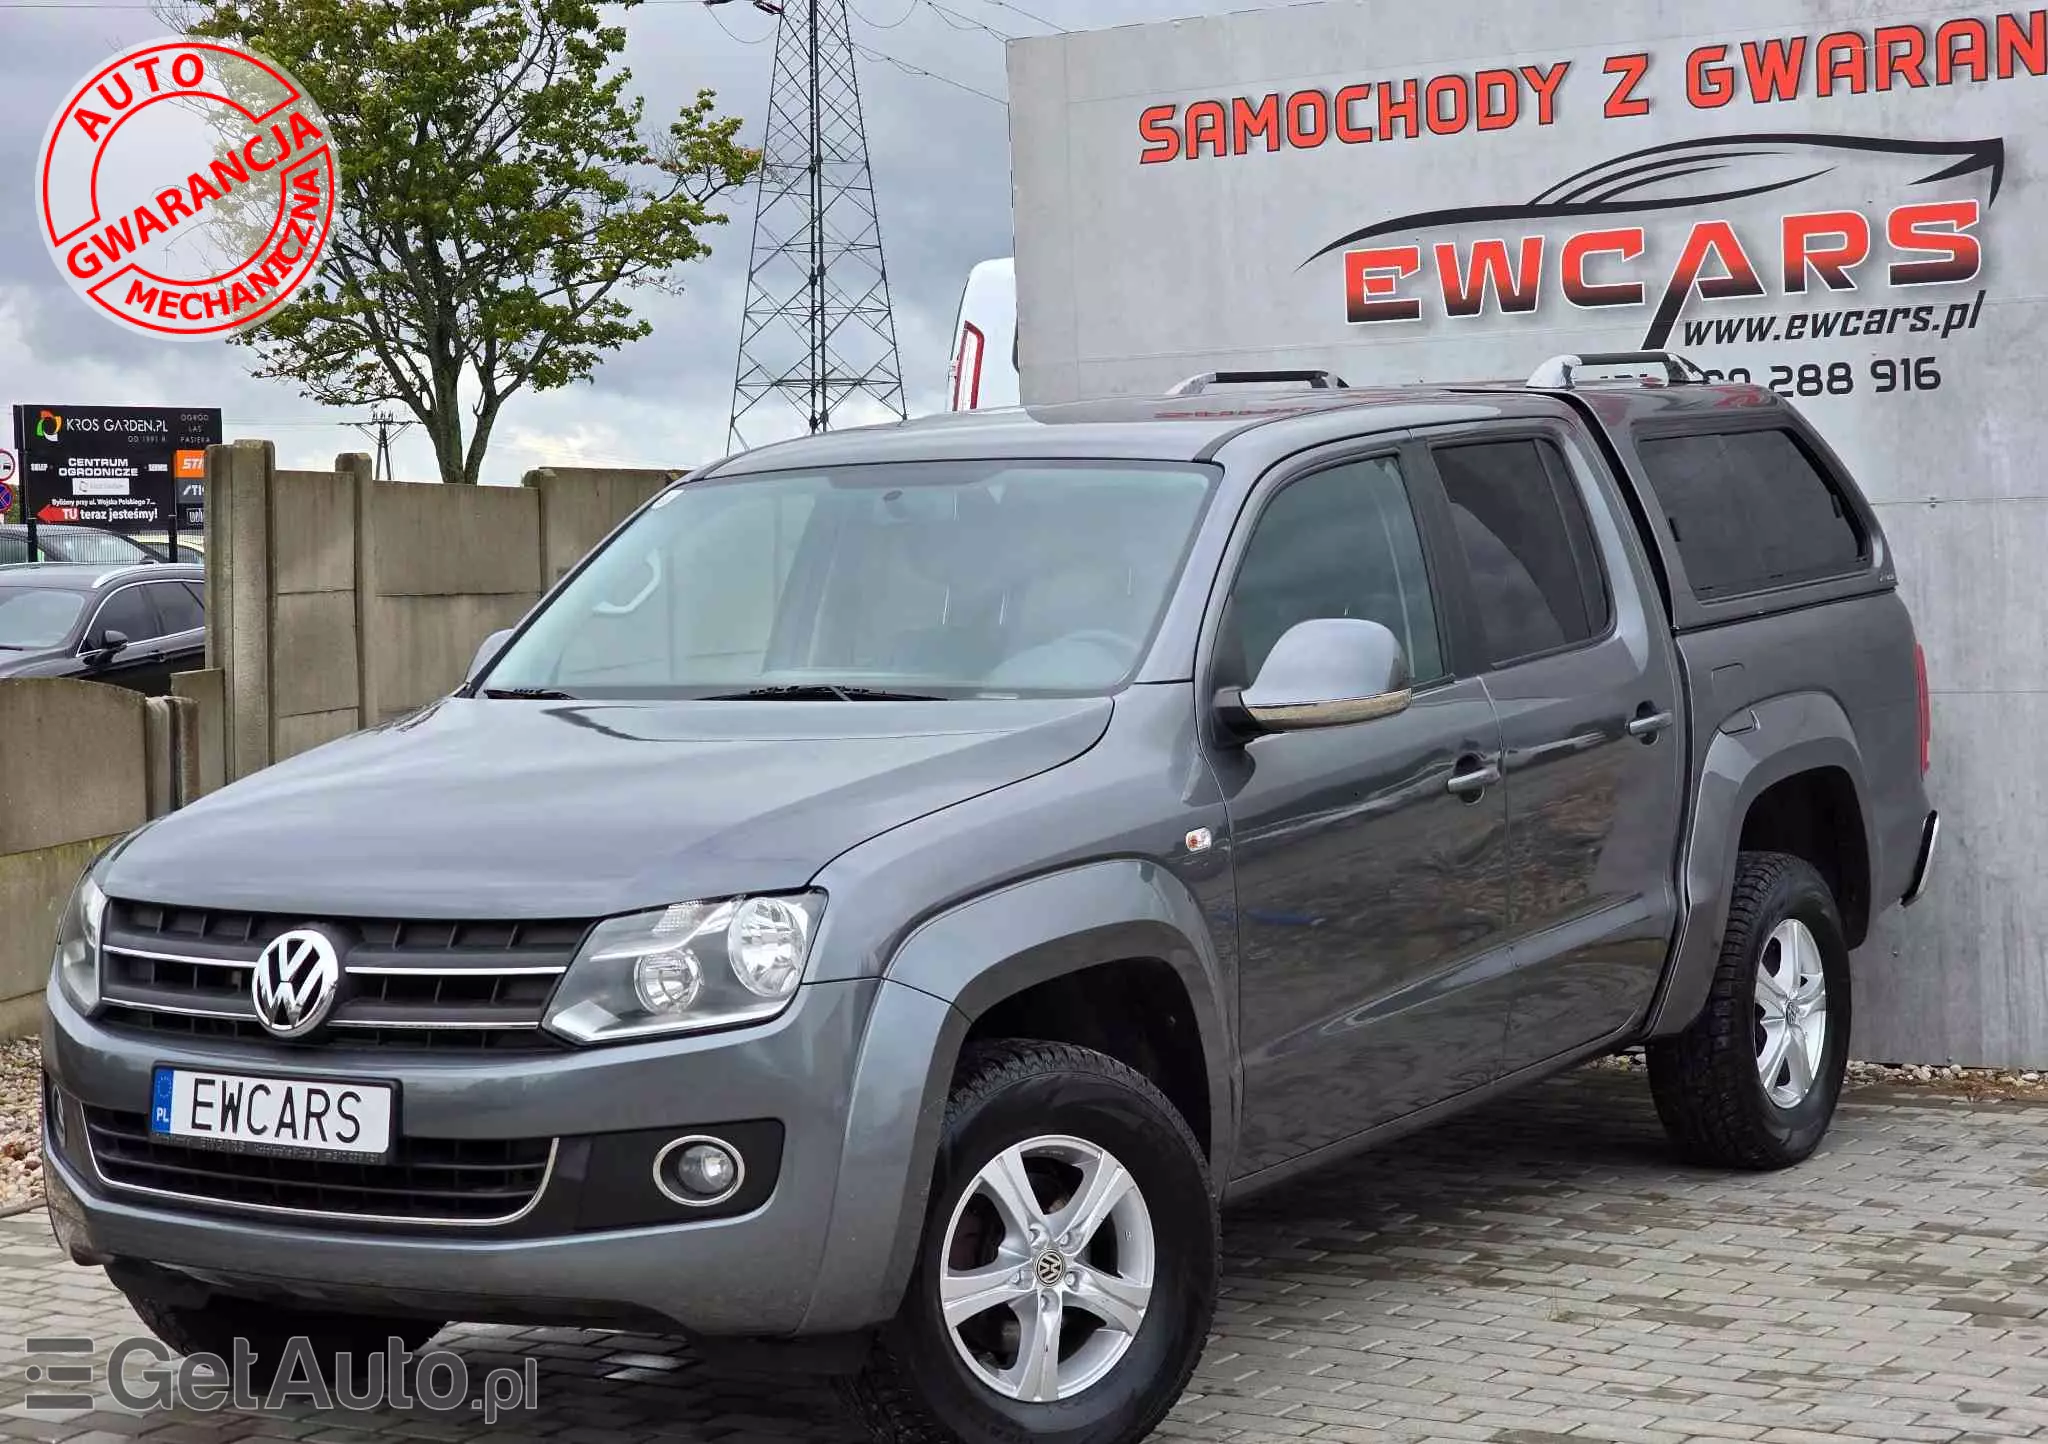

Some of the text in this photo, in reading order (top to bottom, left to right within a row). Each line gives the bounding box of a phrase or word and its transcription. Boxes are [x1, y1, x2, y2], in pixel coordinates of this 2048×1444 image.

[1138, 10, 2048, 165] SAMOCHODY Z GWARAN
[1344, 200, 1982, 351] EWCARS
[1684, 290, 1987, 348] www.ewcars.pl
[1768, 362, 1854, 398] 288
[1870, 356, 1942, 393] 916
[66, 418, 168, 433] KROS GARDEN.PL
[58, 467, 139, 477] OGRODNICZE
[68, 457, 129, 467] CENTRUM
[62, 508, 158, 523] TU teraz jesteśmy!
[156, 1107, 169, 1123] PL
[191, 1078, 362, 1144] EWCARS
